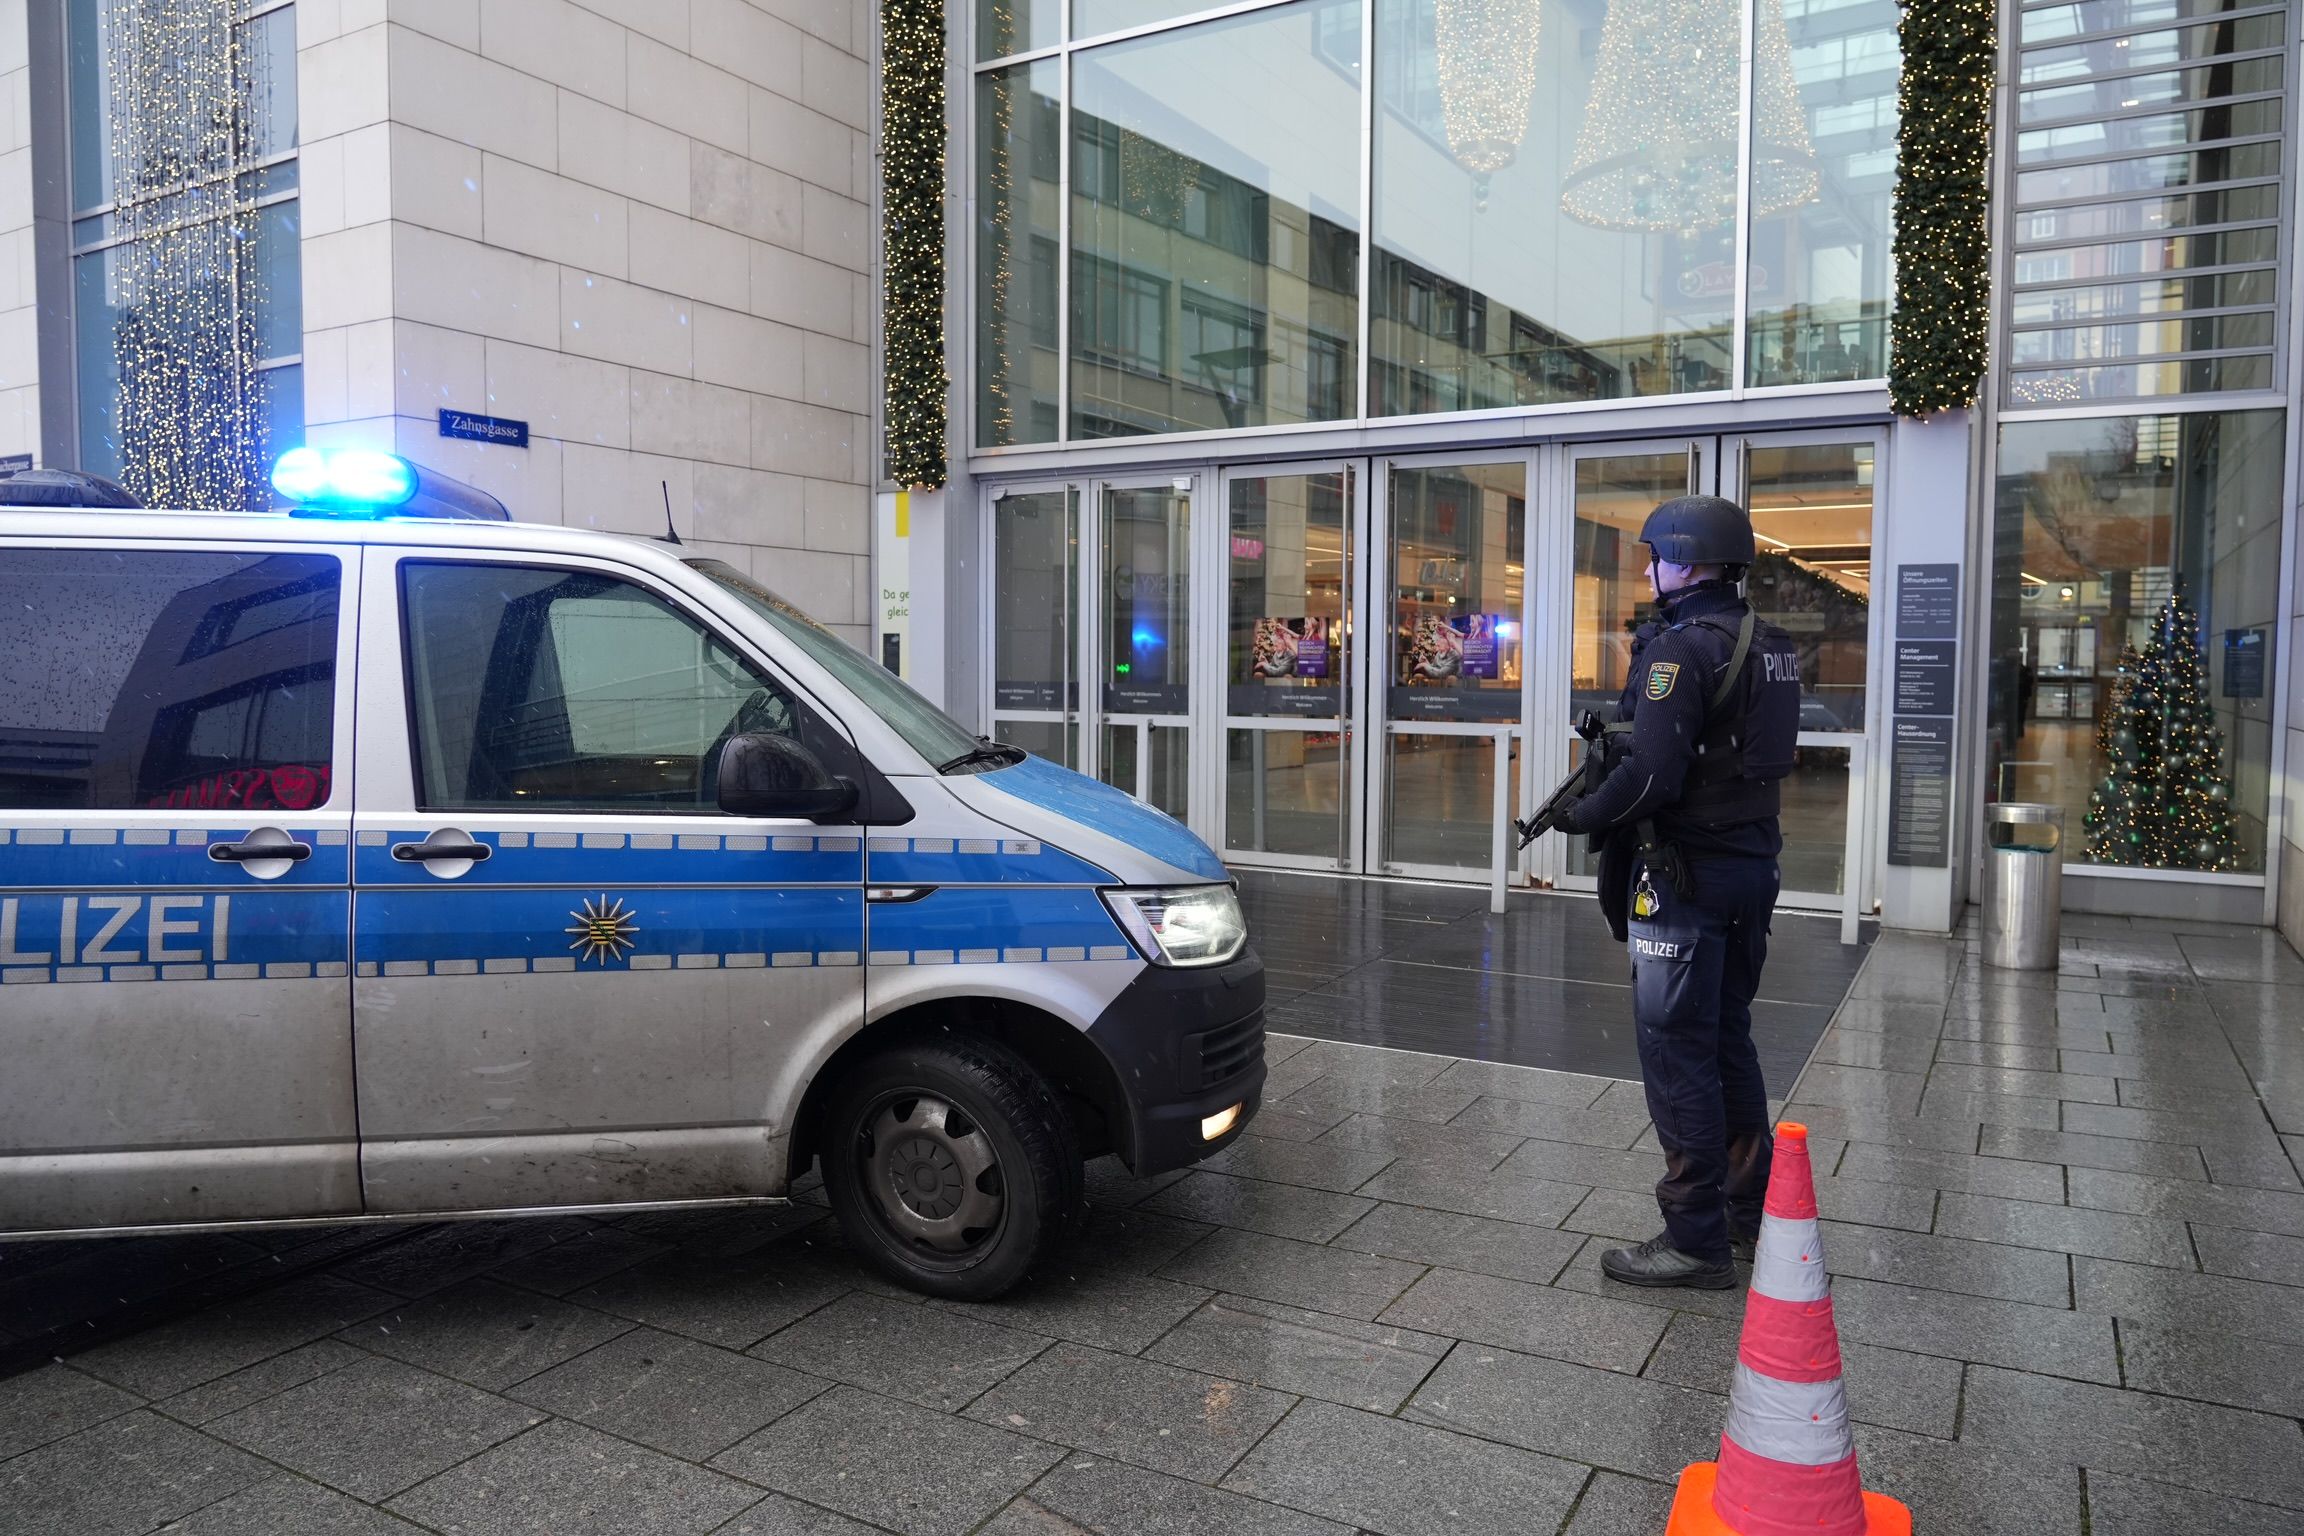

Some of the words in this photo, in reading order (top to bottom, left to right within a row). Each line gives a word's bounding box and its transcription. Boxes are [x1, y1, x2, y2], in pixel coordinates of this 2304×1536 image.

[451, 415, 519, 438] Zahnsgasse
[1902, 577, 1948, 585] Öffnungszeiten
[883, 589, 896, 600] Da
[1652, 665, 1676, 673] POLIZEI
[1897, 731, 1937, 739] Hausordnung
[0, 896, 230, 964] LIZEI
[1635, 938, 1679, 958] POLIZEI
